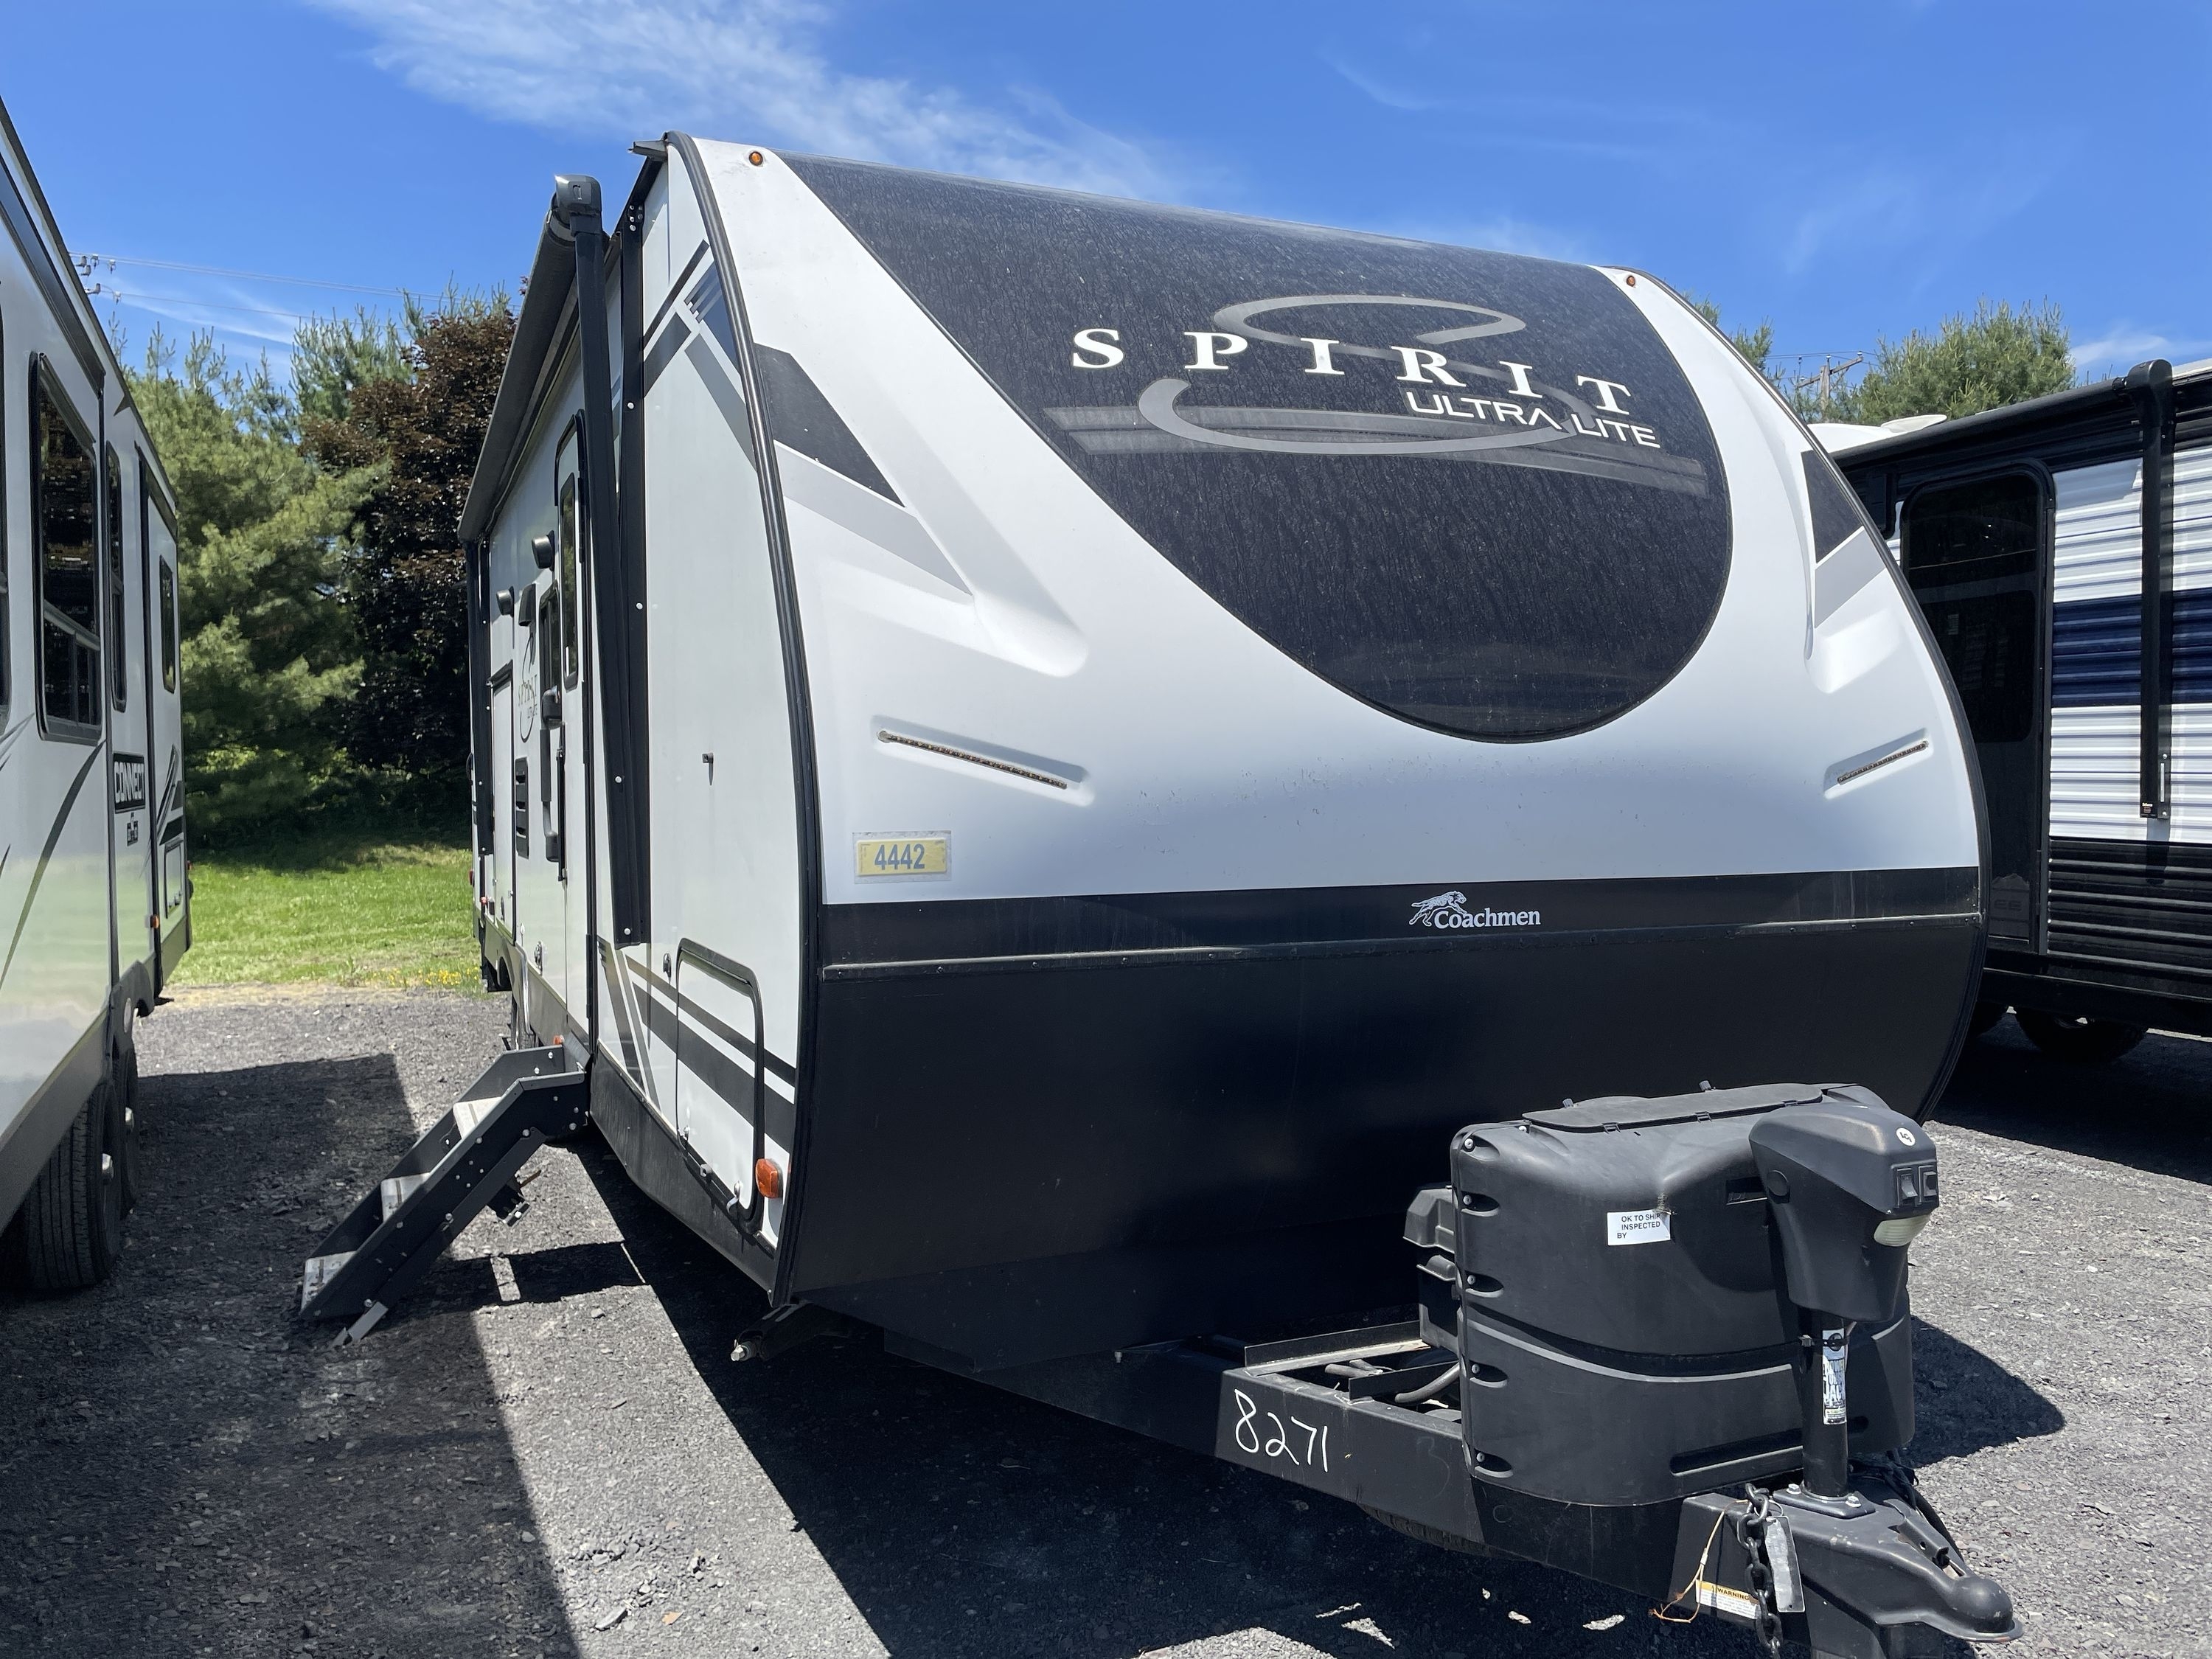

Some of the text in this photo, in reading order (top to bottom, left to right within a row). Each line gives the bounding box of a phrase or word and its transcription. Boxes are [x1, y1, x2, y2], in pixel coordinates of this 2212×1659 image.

[1071, 327, 1632, 416] SPIRIT
[1405, 391, 1661, 448] ULTRA LITE
[874, 843, 925, 871] 4442
[1433, 907, 1541, 929] Coachmen
[1621, 1221, 1660, 1231] INSPECTED
[1234, 1388, 1328, 1473] 8271
[1717, 1587, 1750, 1601] WARNING
